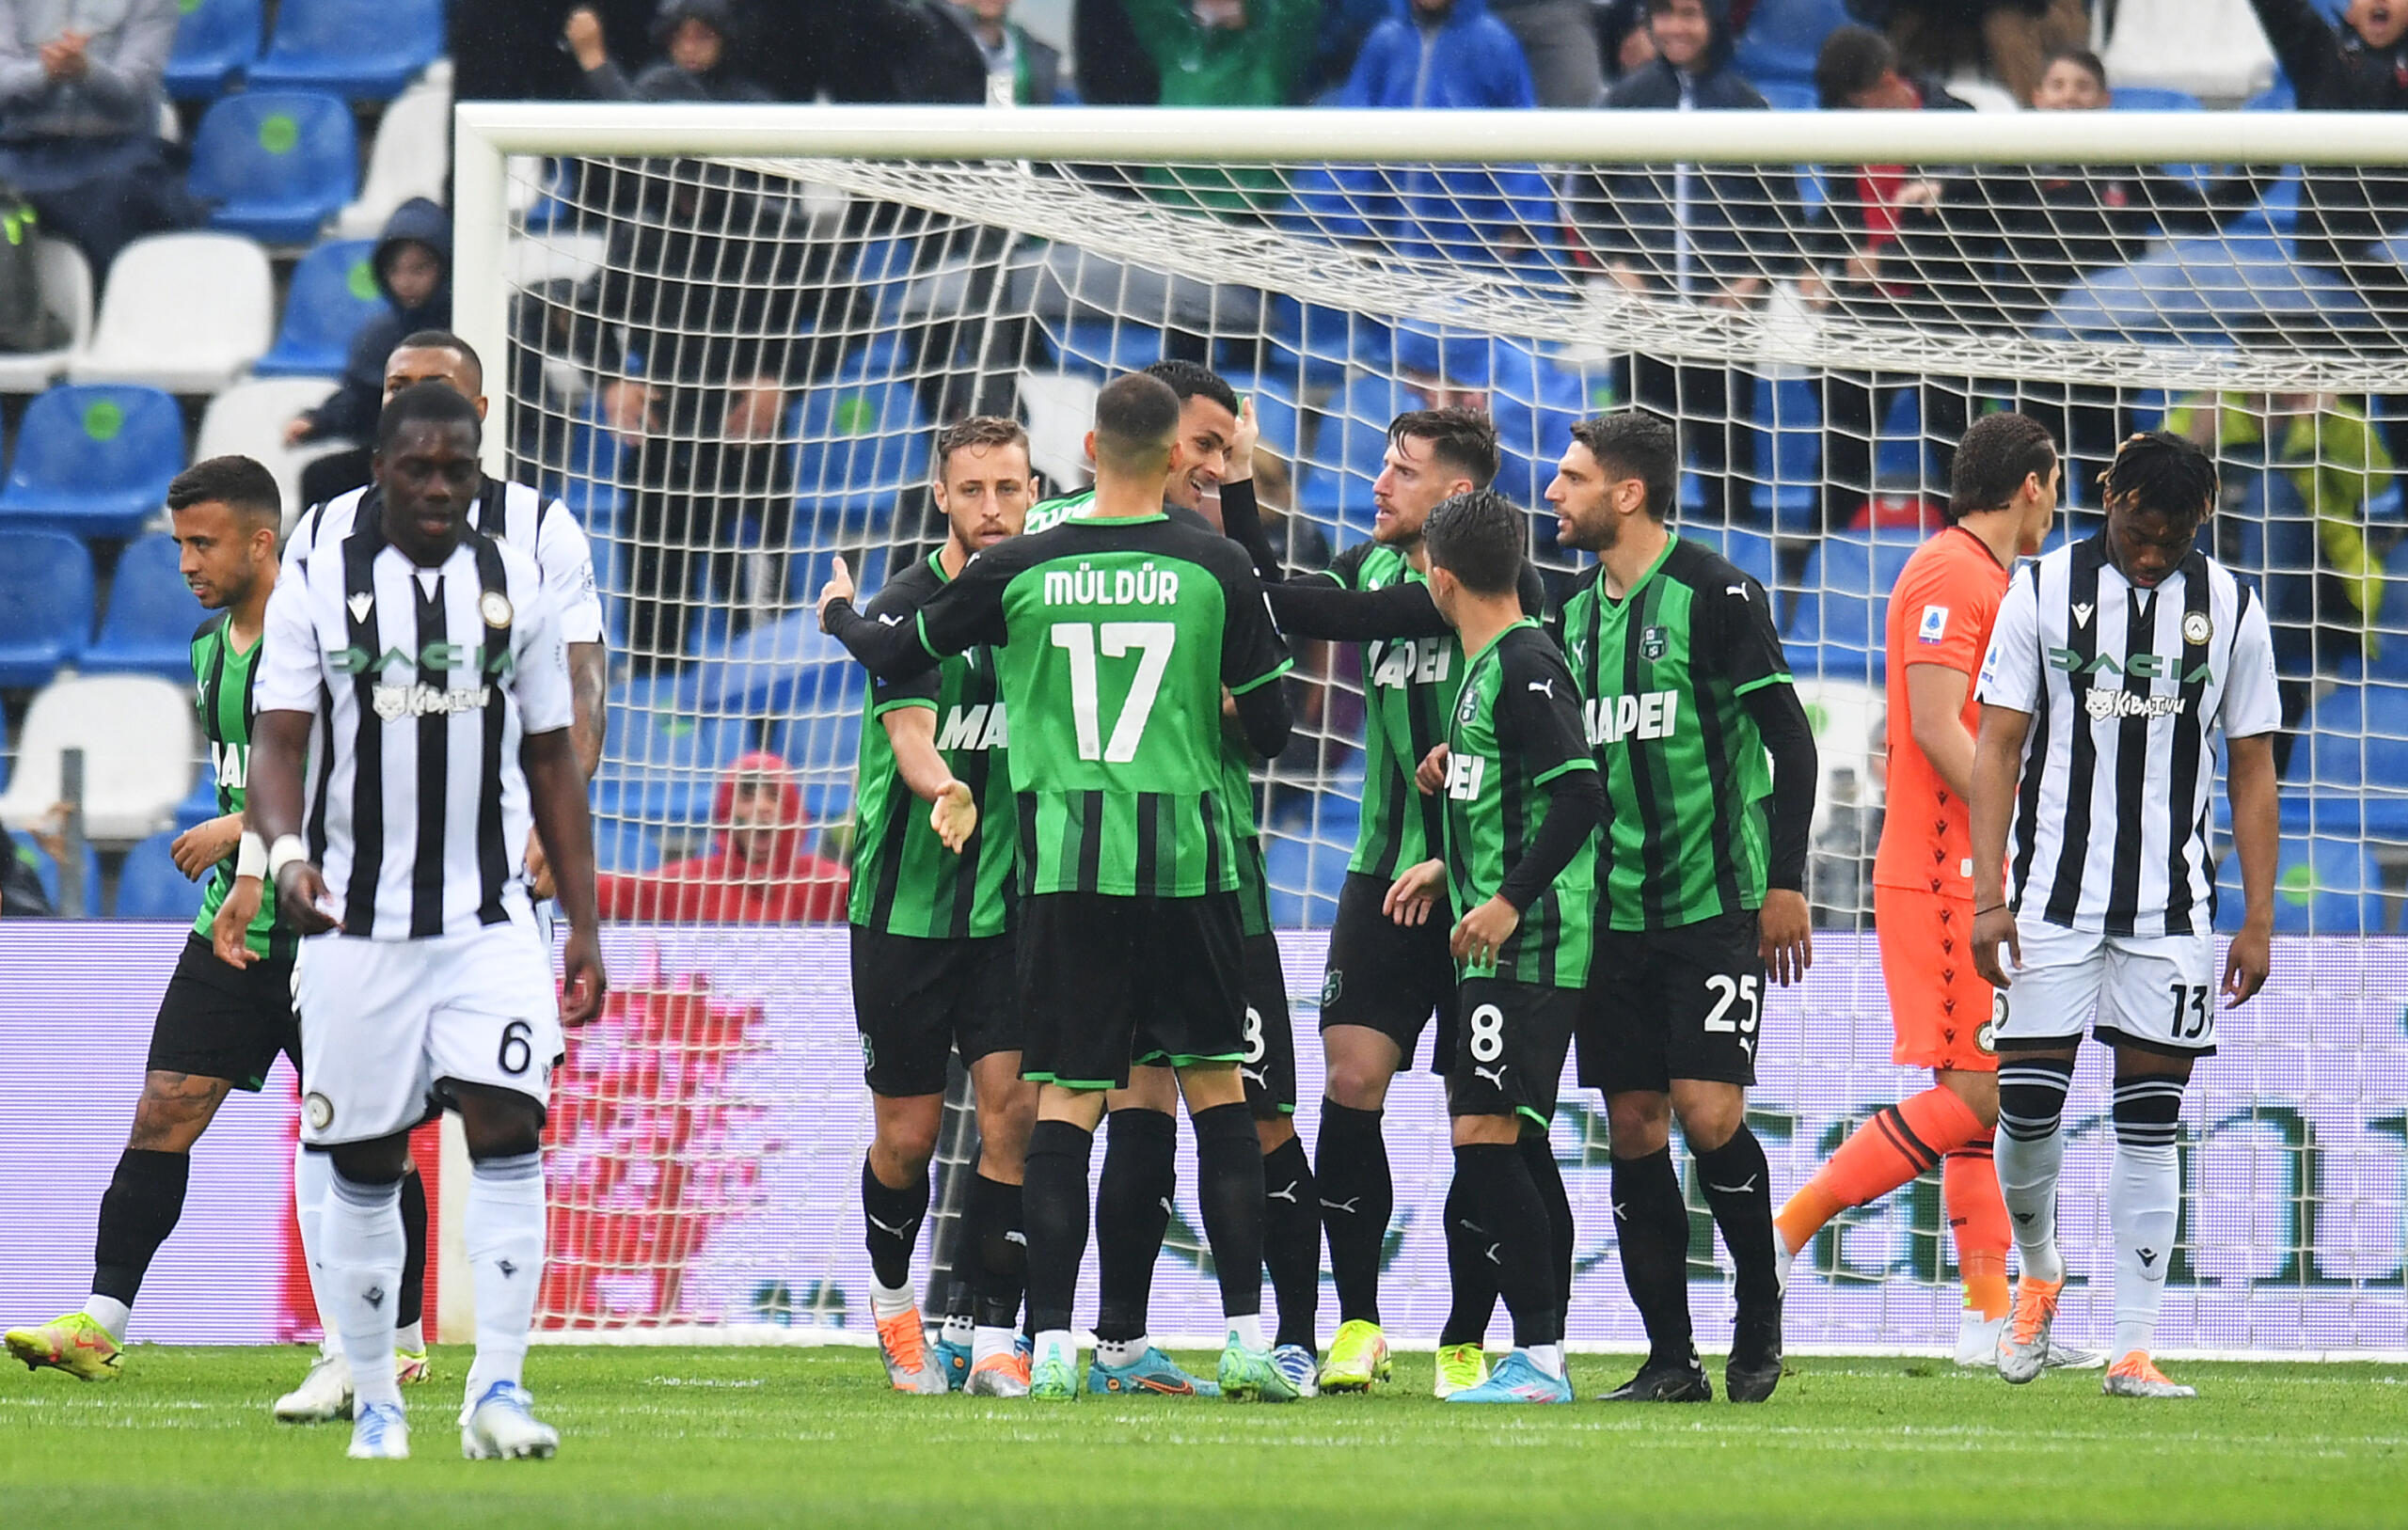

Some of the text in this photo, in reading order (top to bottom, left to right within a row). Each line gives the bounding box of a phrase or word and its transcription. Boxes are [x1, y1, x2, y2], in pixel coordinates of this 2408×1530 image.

[1044, 562, 1179, 606] MÜLDÜR
[1051, 622, 1176, 763] 17
[1703, 974, 1758, 1033] 25
[2169, 984, 2208, 1039] 13
[498, 1019, 533, 1075] 6
[1470, 1003, 1504, 1063] 8
